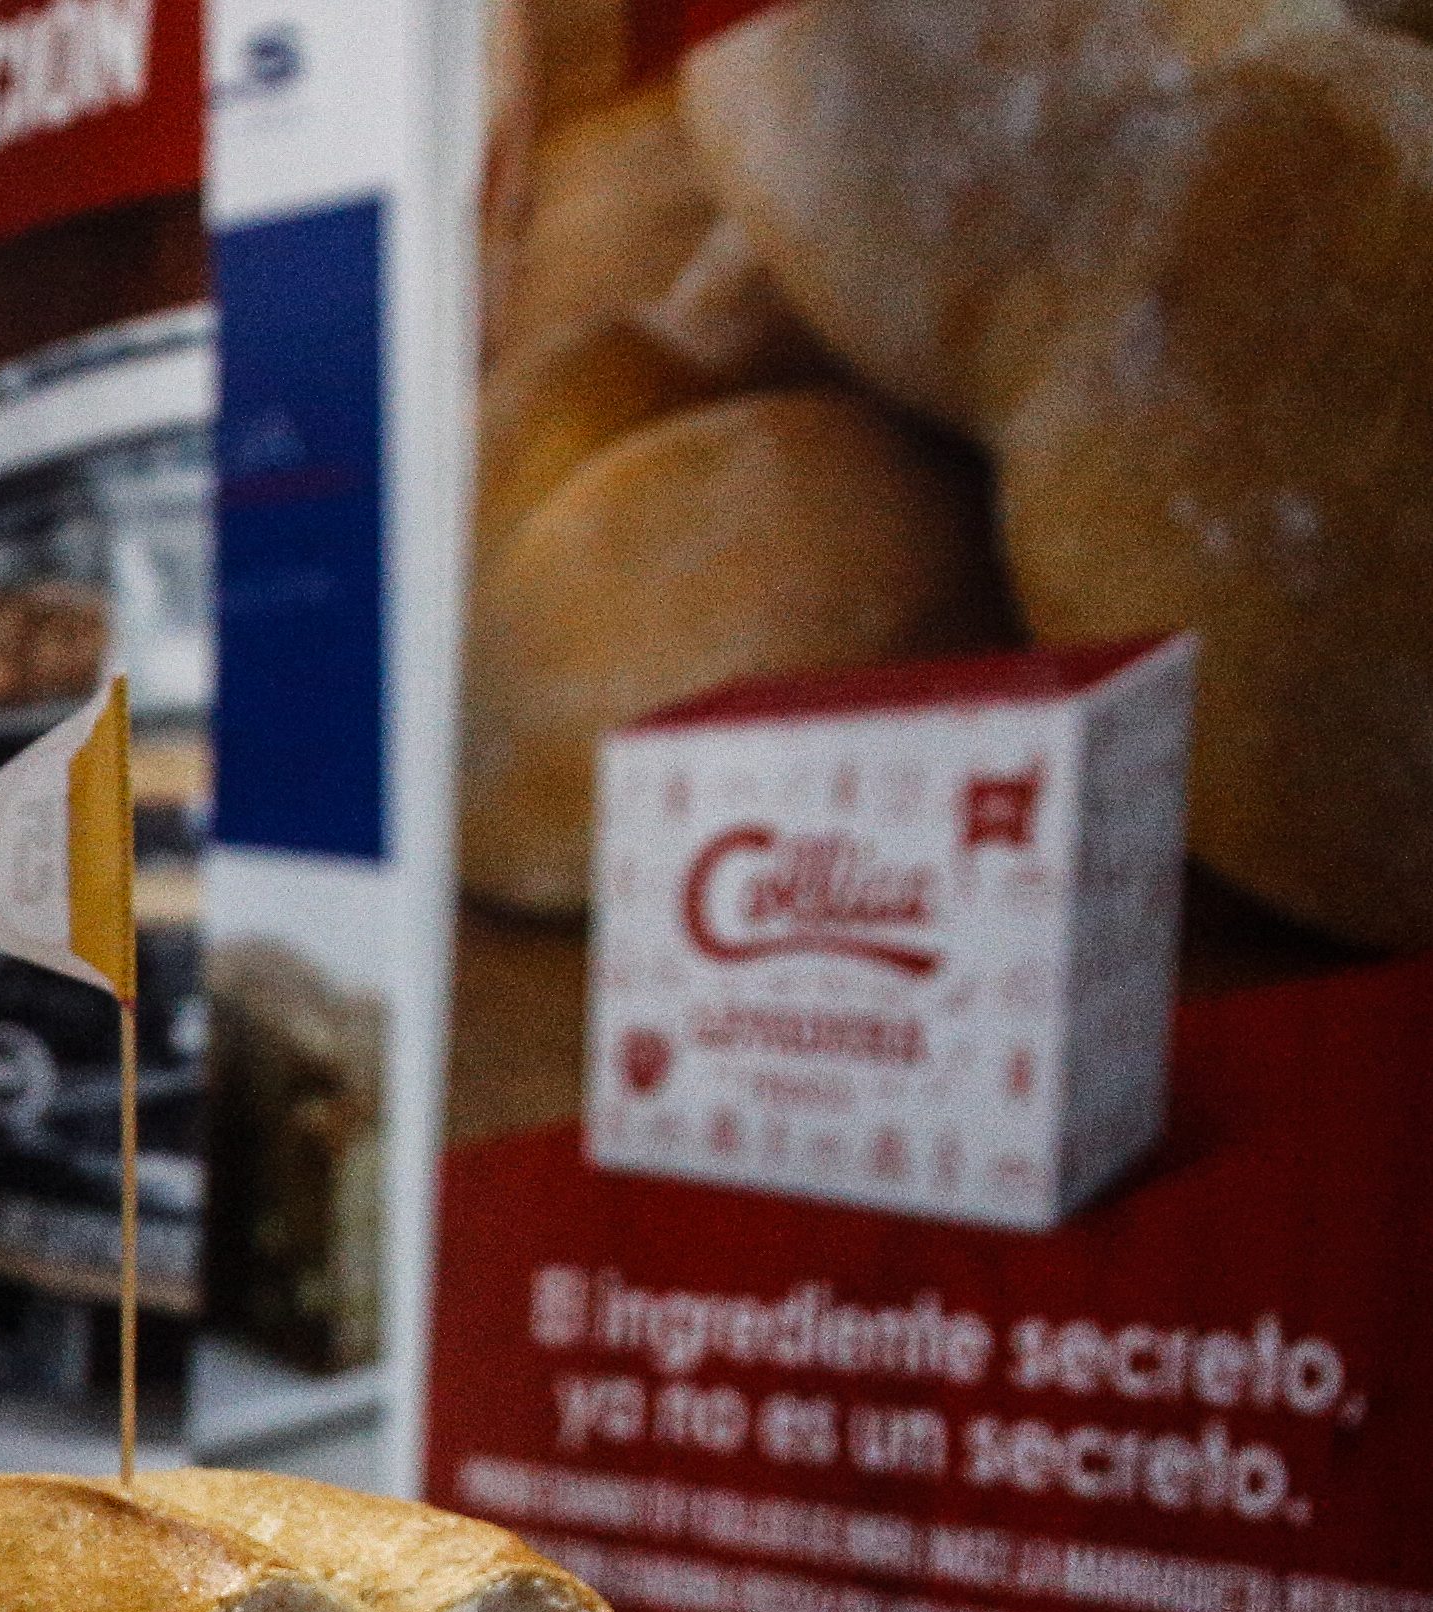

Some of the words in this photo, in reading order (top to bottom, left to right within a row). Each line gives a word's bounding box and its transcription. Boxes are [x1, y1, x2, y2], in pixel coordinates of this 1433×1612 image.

[528, 1264, 594, 1348] El
[596, 1268, 994, 1388] ingrediente
[555, 1374, 647, 1452] ya
[655, 1381, 751, 1454] no
[758, 1398, 841, 1467] es
[850, 1408, 950, 1478] un
